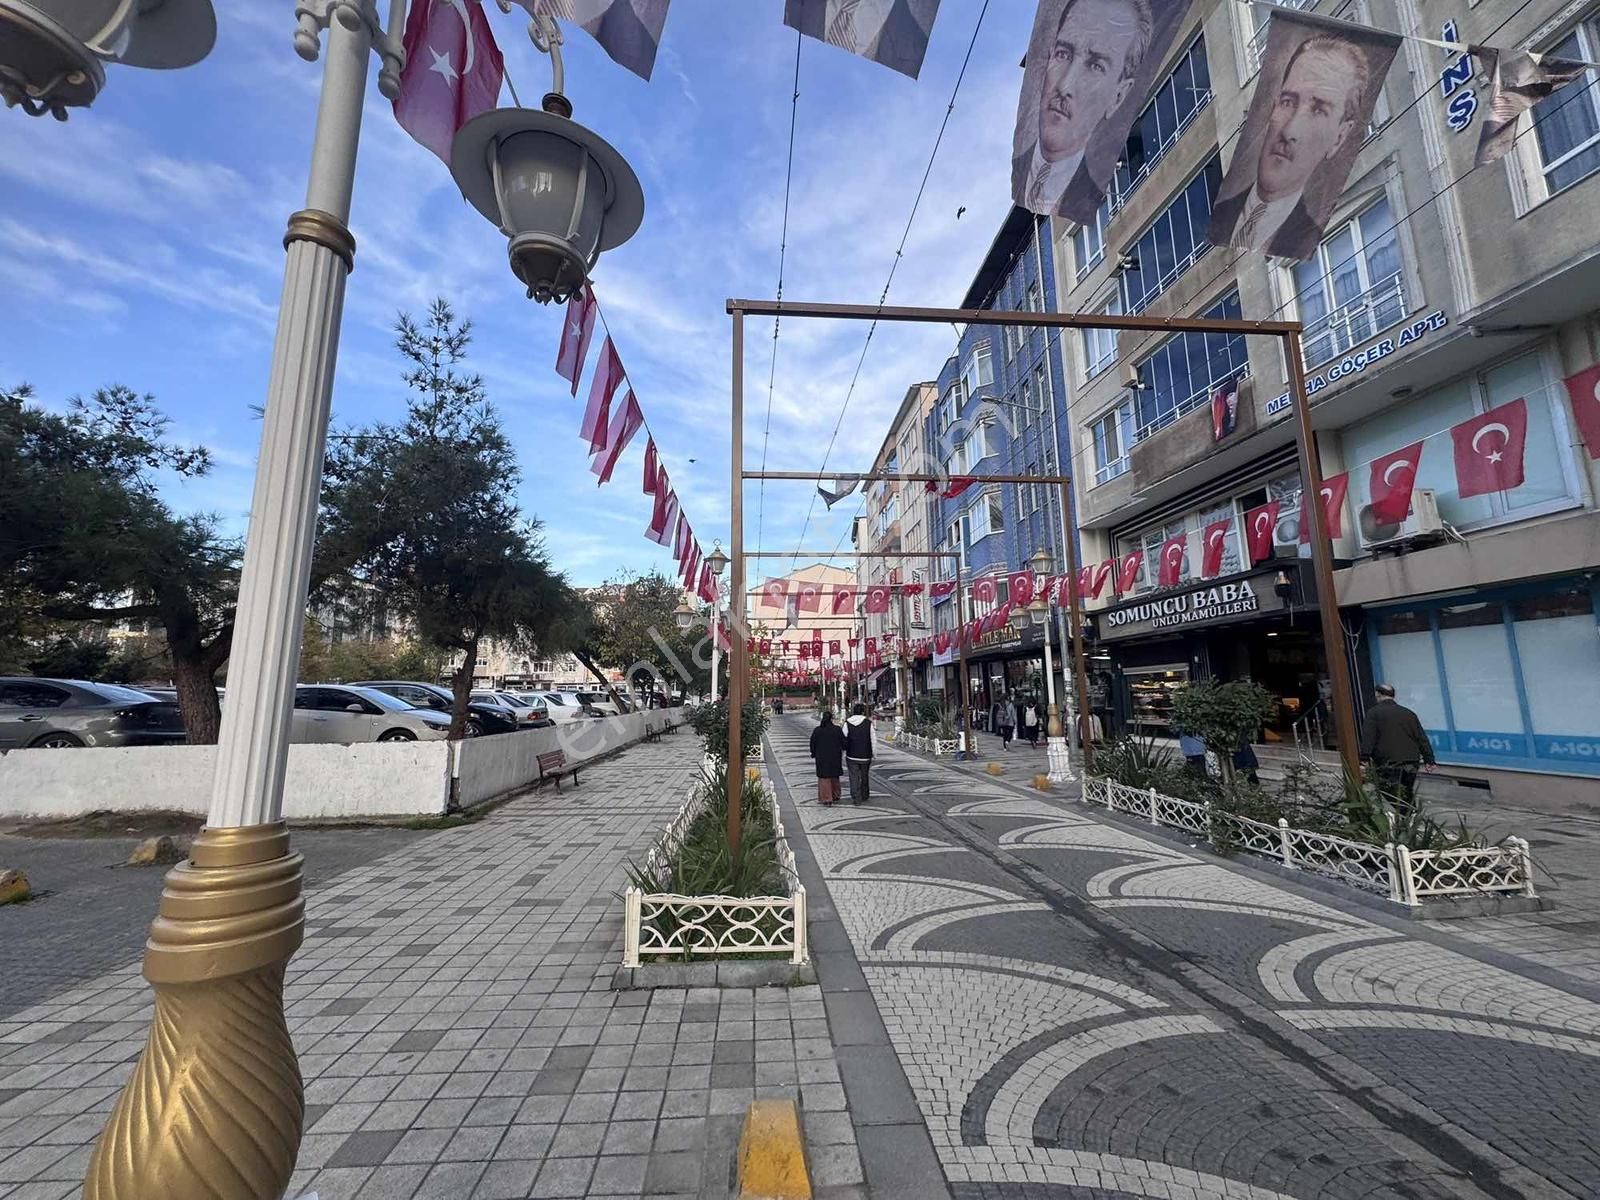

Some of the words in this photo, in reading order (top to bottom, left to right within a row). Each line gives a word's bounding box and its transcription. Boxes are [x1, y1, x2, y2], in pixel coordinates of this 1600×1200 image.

[1267, 374, 1327, 416] MEHA
[1329, 338, 1395, 383] GÖÇER
[1399, 310, 1448, 348] APT.
[1108, 596, 1187, 627] SOMUNCU
[1192, 580, 1256, 609] BABA
[1152, 614, 1180, 628] UNLU
[1181, 597, 1258, 623] MAMÜLLERİ
